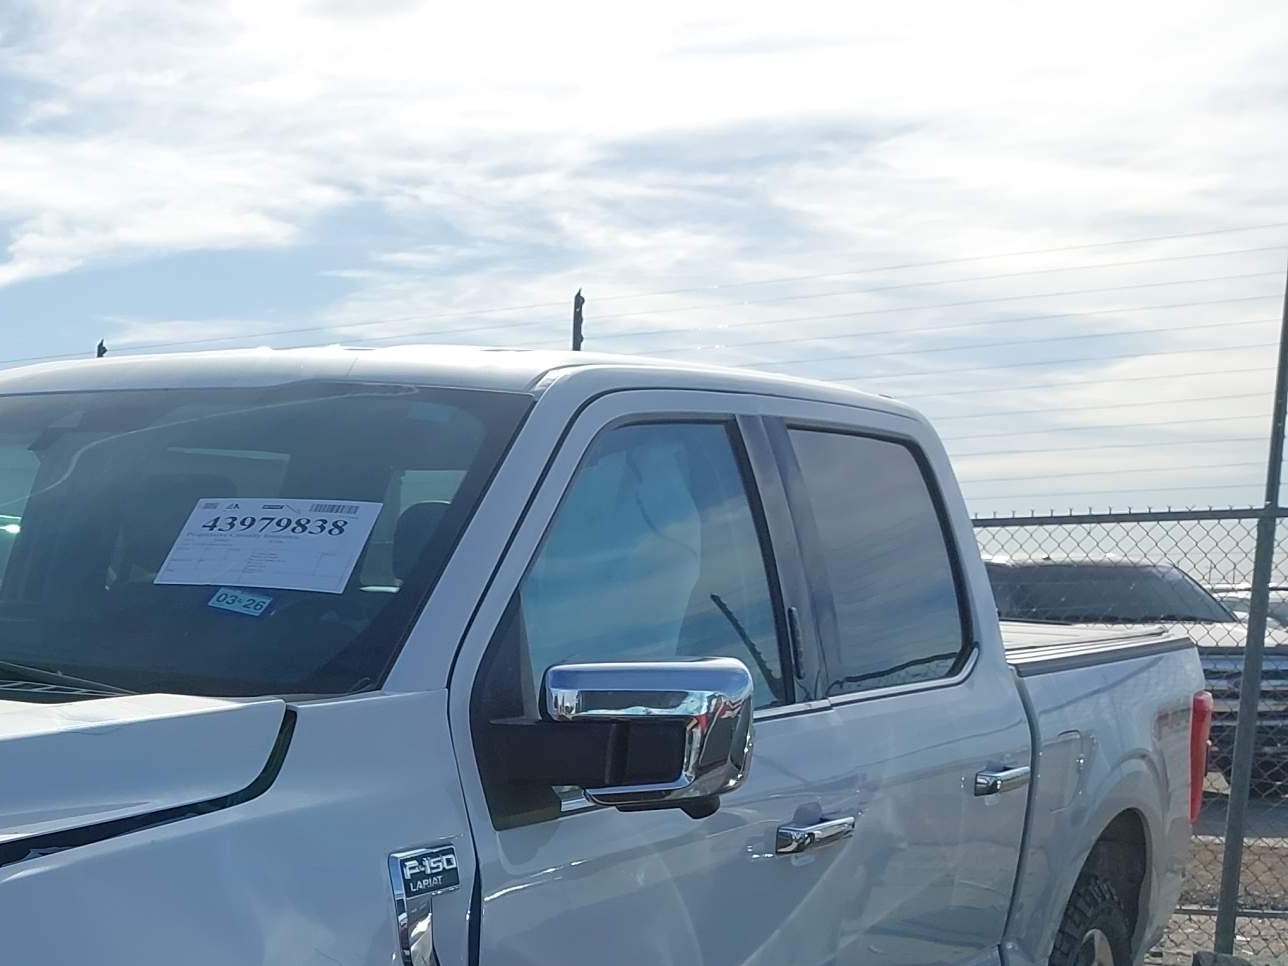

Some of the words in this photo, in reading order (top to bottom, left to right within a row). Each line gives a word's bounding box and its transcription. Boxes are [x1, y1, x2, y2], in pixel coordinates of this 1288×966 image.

[201, 515, 349, 537] 43979838
[403, 854, 457, 880] F-150
[409, 875, 443, 892] LARIAT
